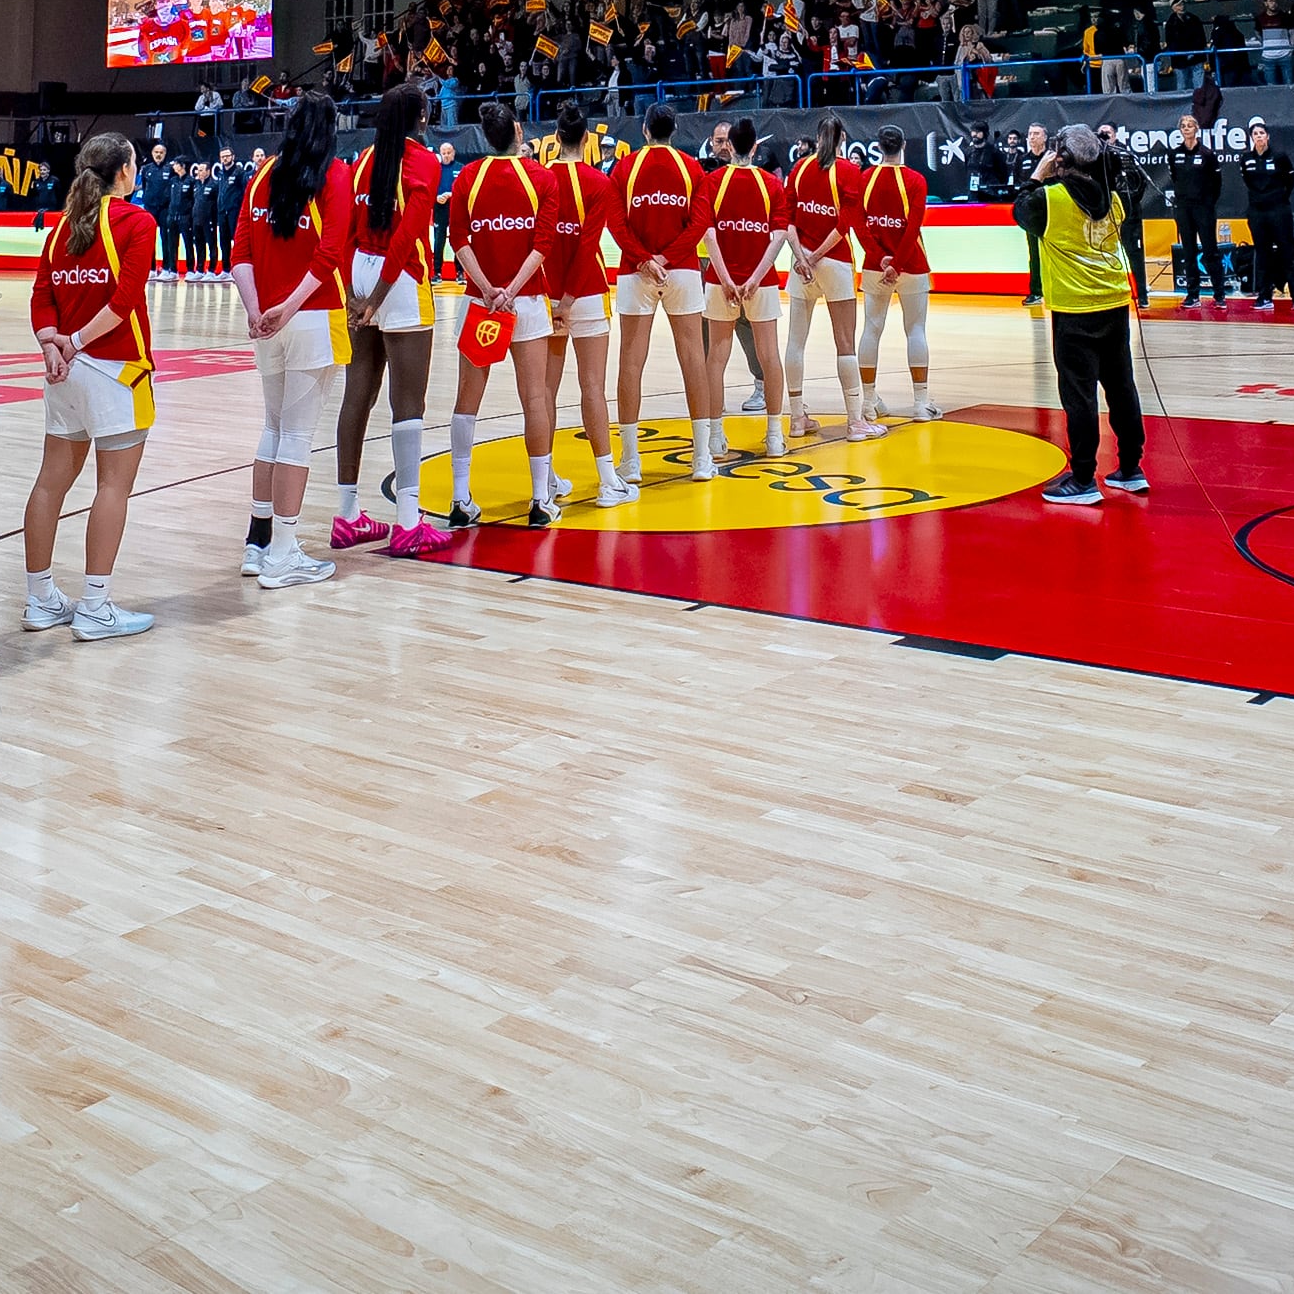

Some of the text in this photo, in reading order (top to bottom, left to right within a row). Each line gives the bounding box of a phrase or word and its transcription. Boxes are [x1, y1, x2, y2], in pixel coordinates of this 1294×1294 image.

[632, 190, 687, 208] endesa
[471, 214, 535, 233] endesa
[717, 217, 770, 234] endesa
[52, 265, 109, 285] endesa
